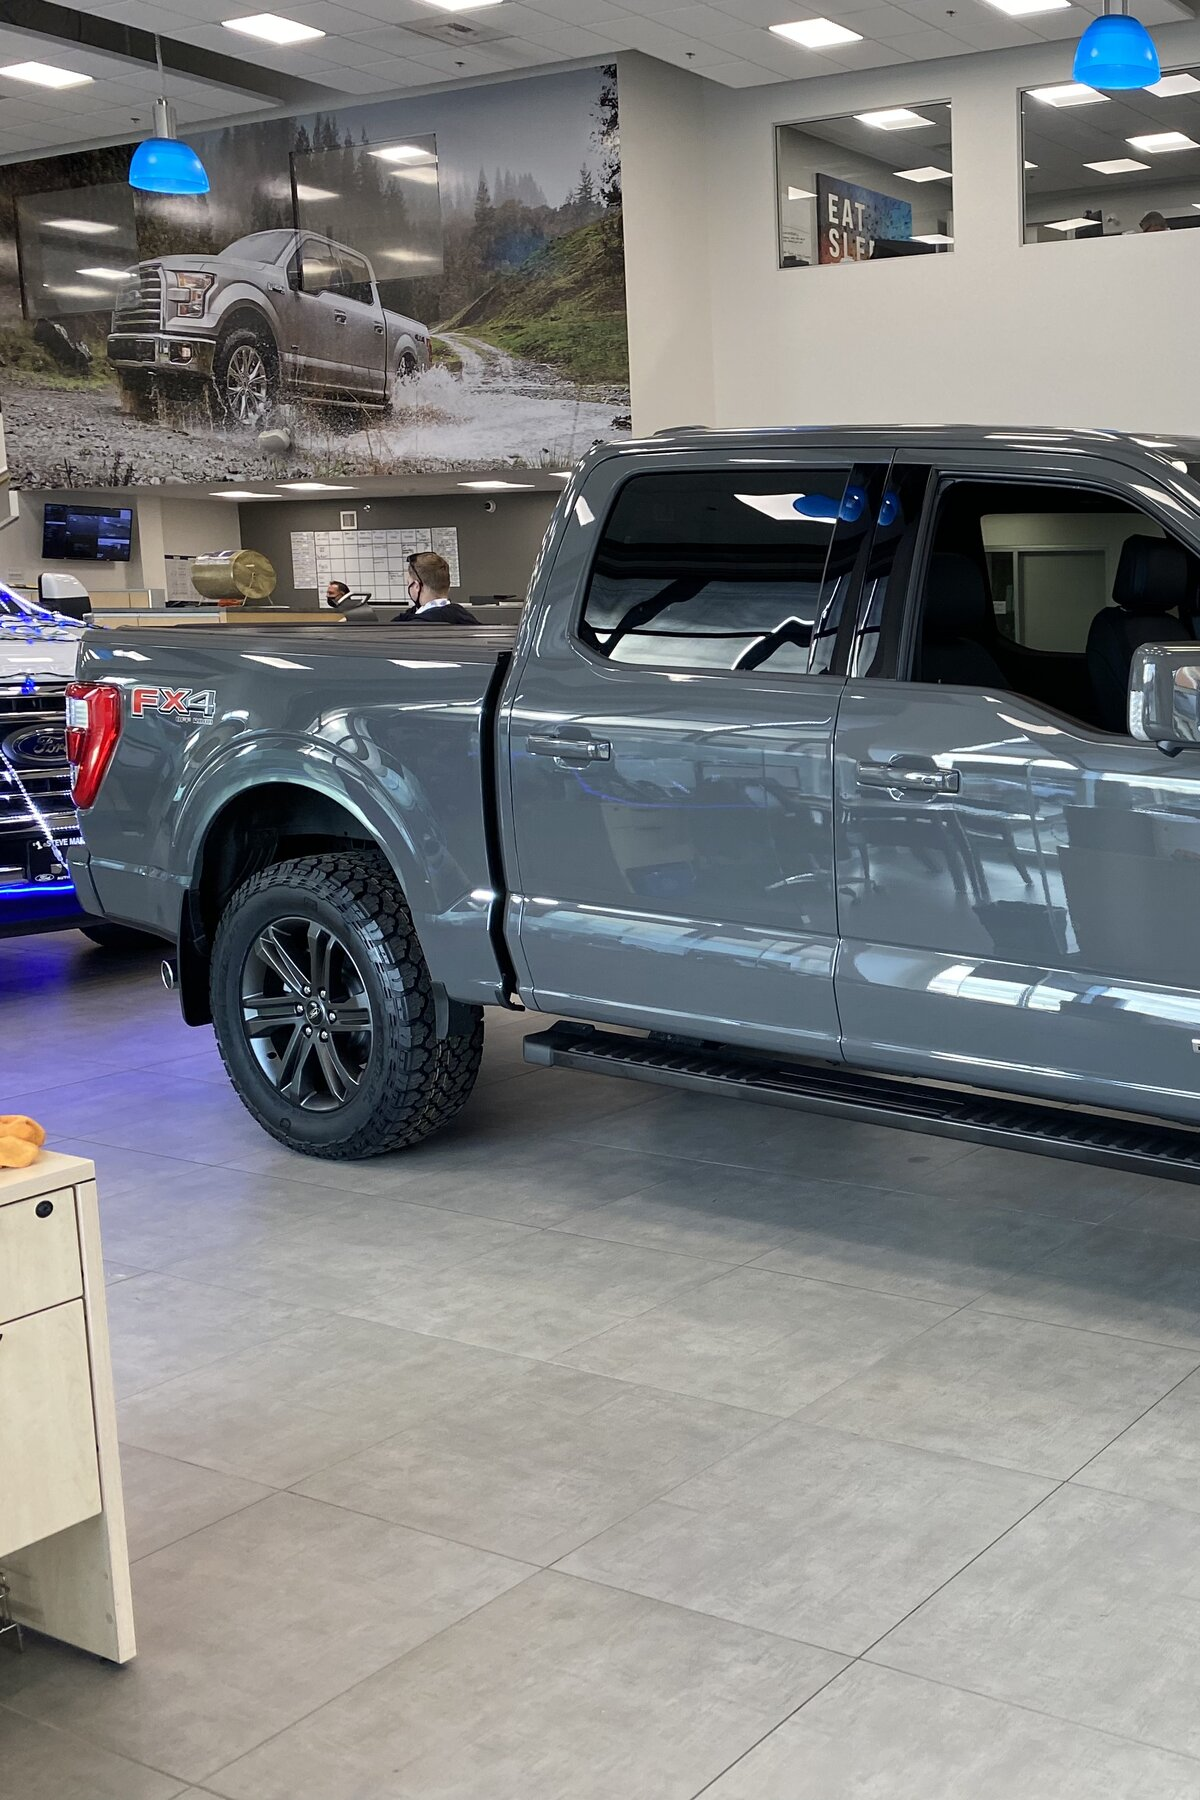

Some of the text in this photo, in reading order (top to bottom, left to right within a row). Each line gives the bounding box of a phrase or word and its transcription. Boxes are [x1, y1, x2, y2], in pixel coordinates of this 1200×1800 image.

[828, 193, 866, 231] EAT
[132, 687, 216, 718] FX4
[33, 735, 67, 754] For
